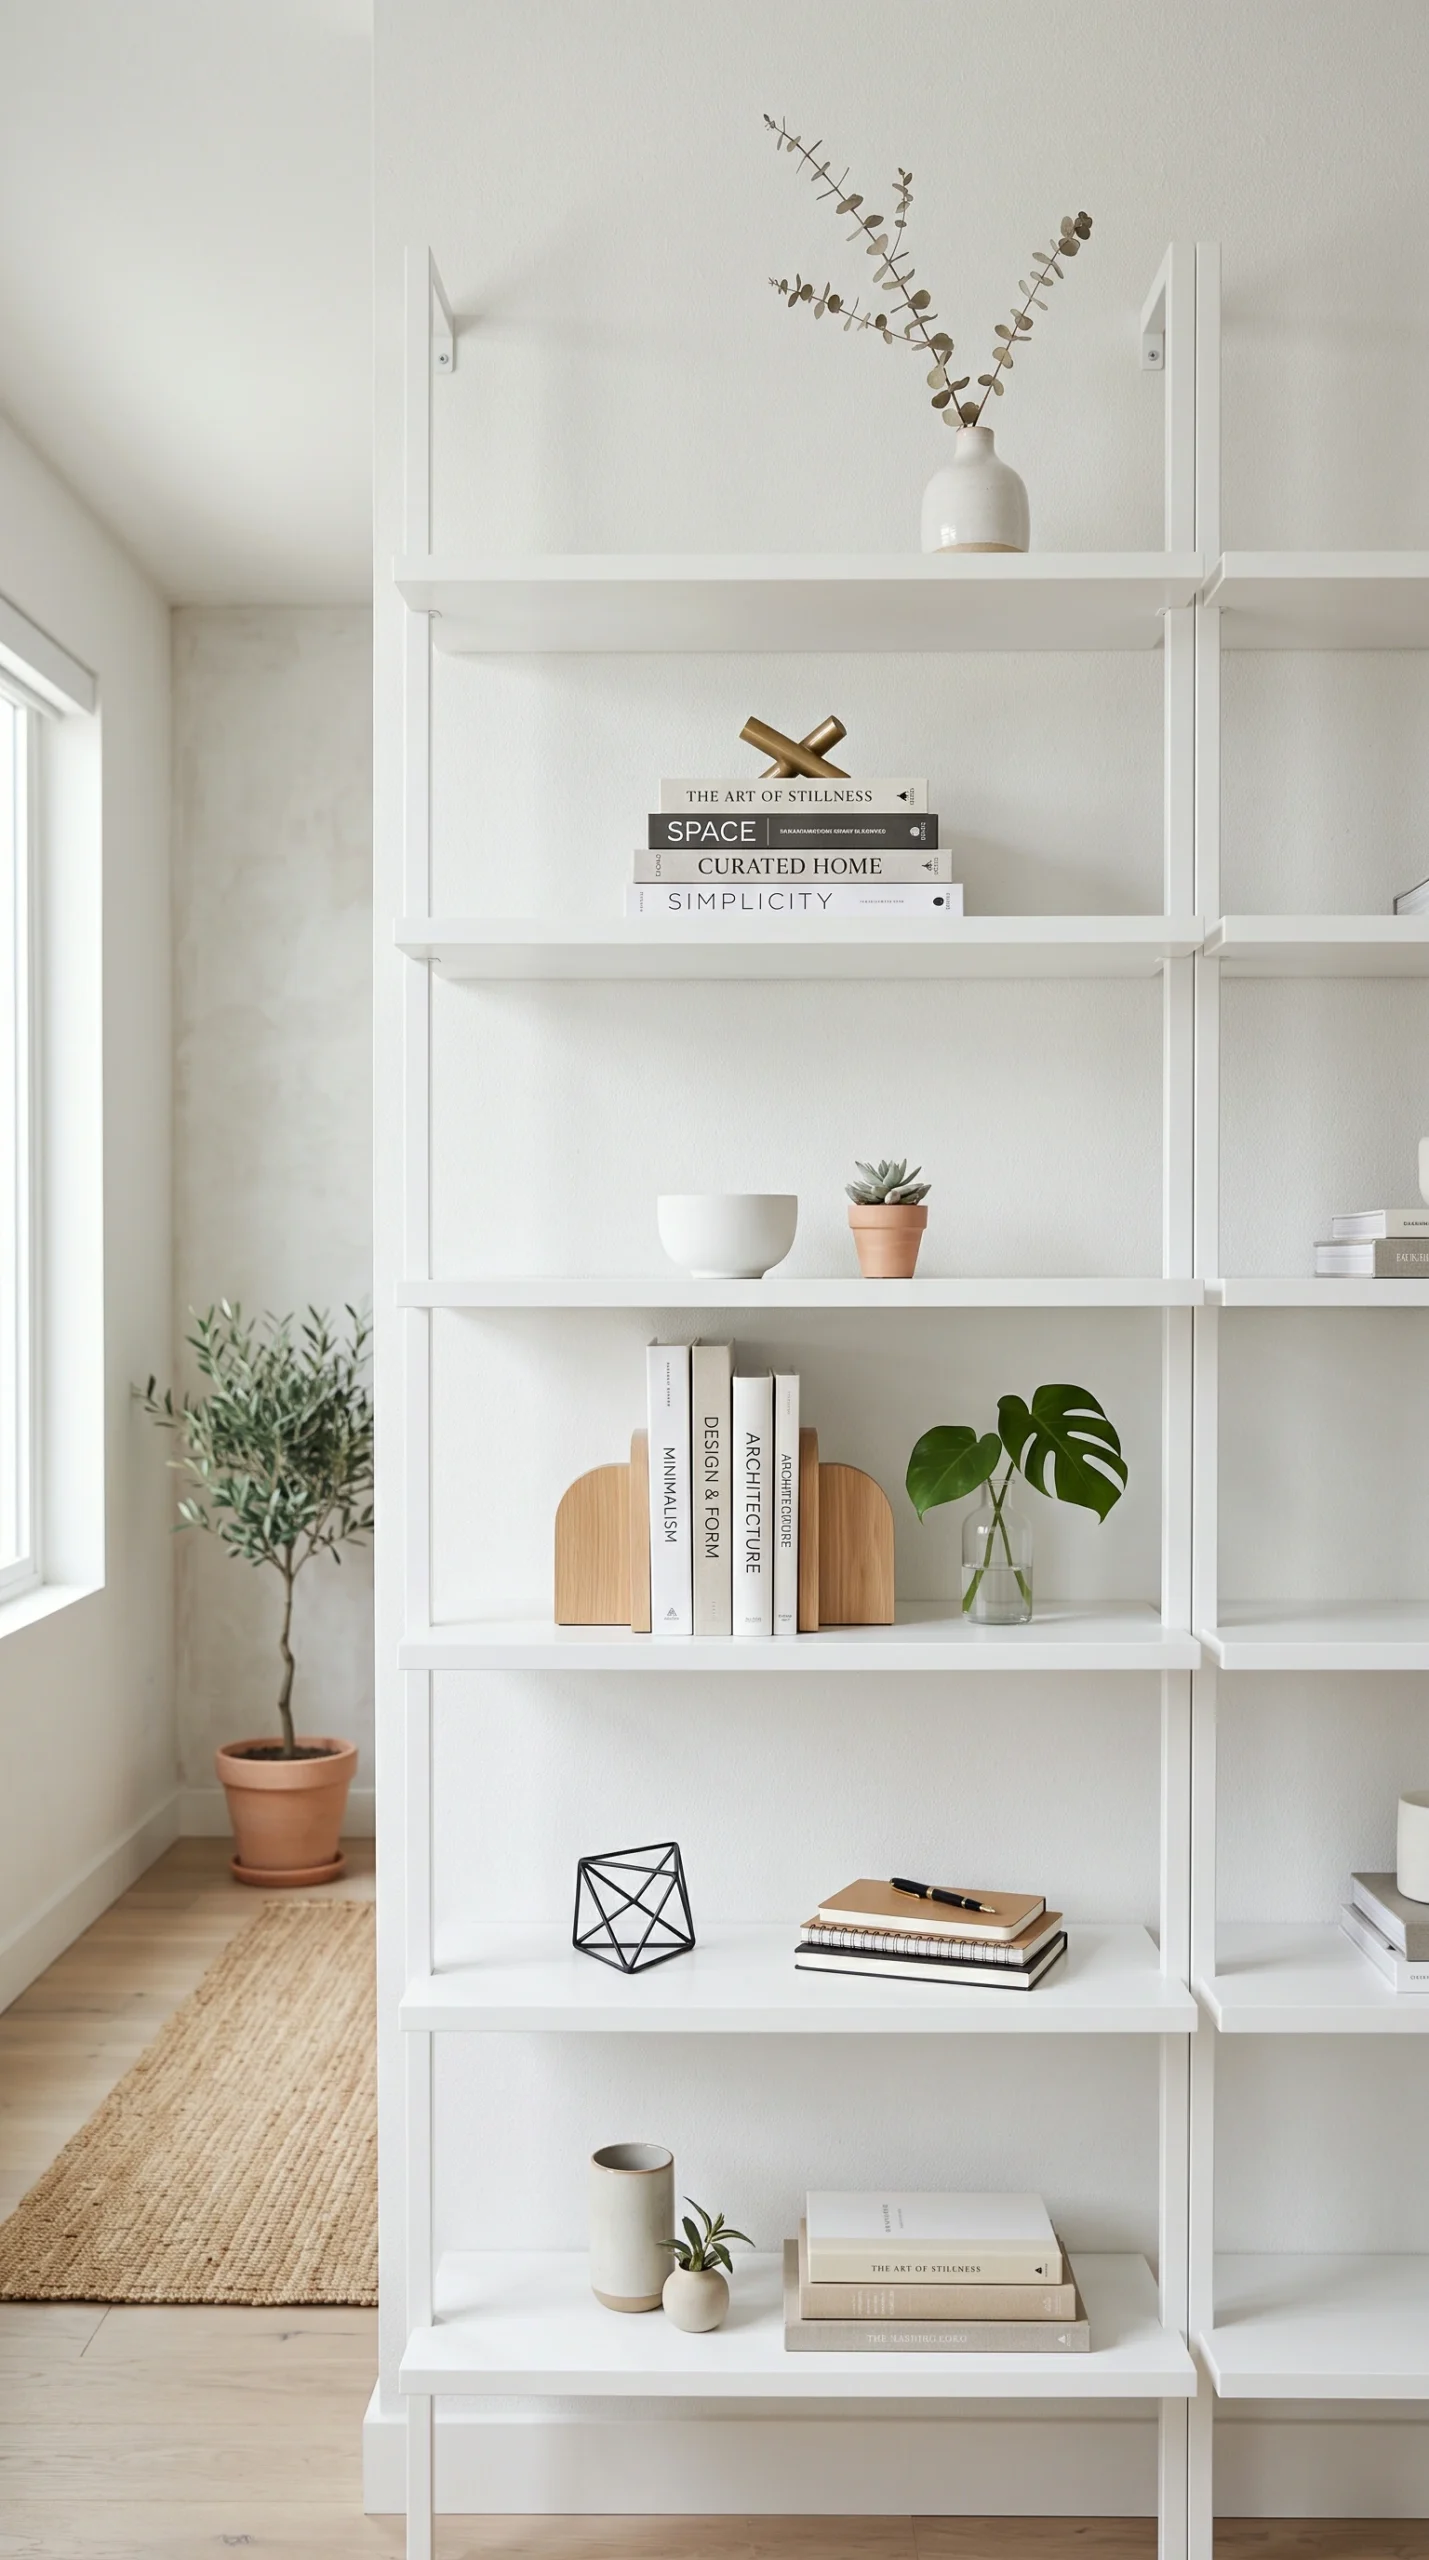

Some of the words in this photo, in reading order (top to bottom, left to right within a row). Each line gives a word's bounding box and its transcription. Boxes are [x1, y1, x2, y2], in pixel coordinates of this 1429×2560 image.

[686, 790, 719, 803] THE
[724, 790, 756, 803] ART
[761, 790, 783, 803] OF
[788, 790, 873, 803] STILLNESS
[667, 821, 756, 842] SPACE
[698, 857, 806, 875] CURATED
[813, 857, 883, 875] HOME
[668, 893, 833, 910] SIMPLICITY
[704, 1416, 719, 1482] DESIGN
[663, 1447, 678, 1543] MINIMALISM
[704, 1488, 719, 1501] &
[745, 1432, 761, 1574] ARCHITECTURE
[704, 1507, 719, 1559] FORM
[871, 2264, 890, 2273] THE
[893, 2265, 912, 2273] ART
[914, 2265, 928, 2273] OF
